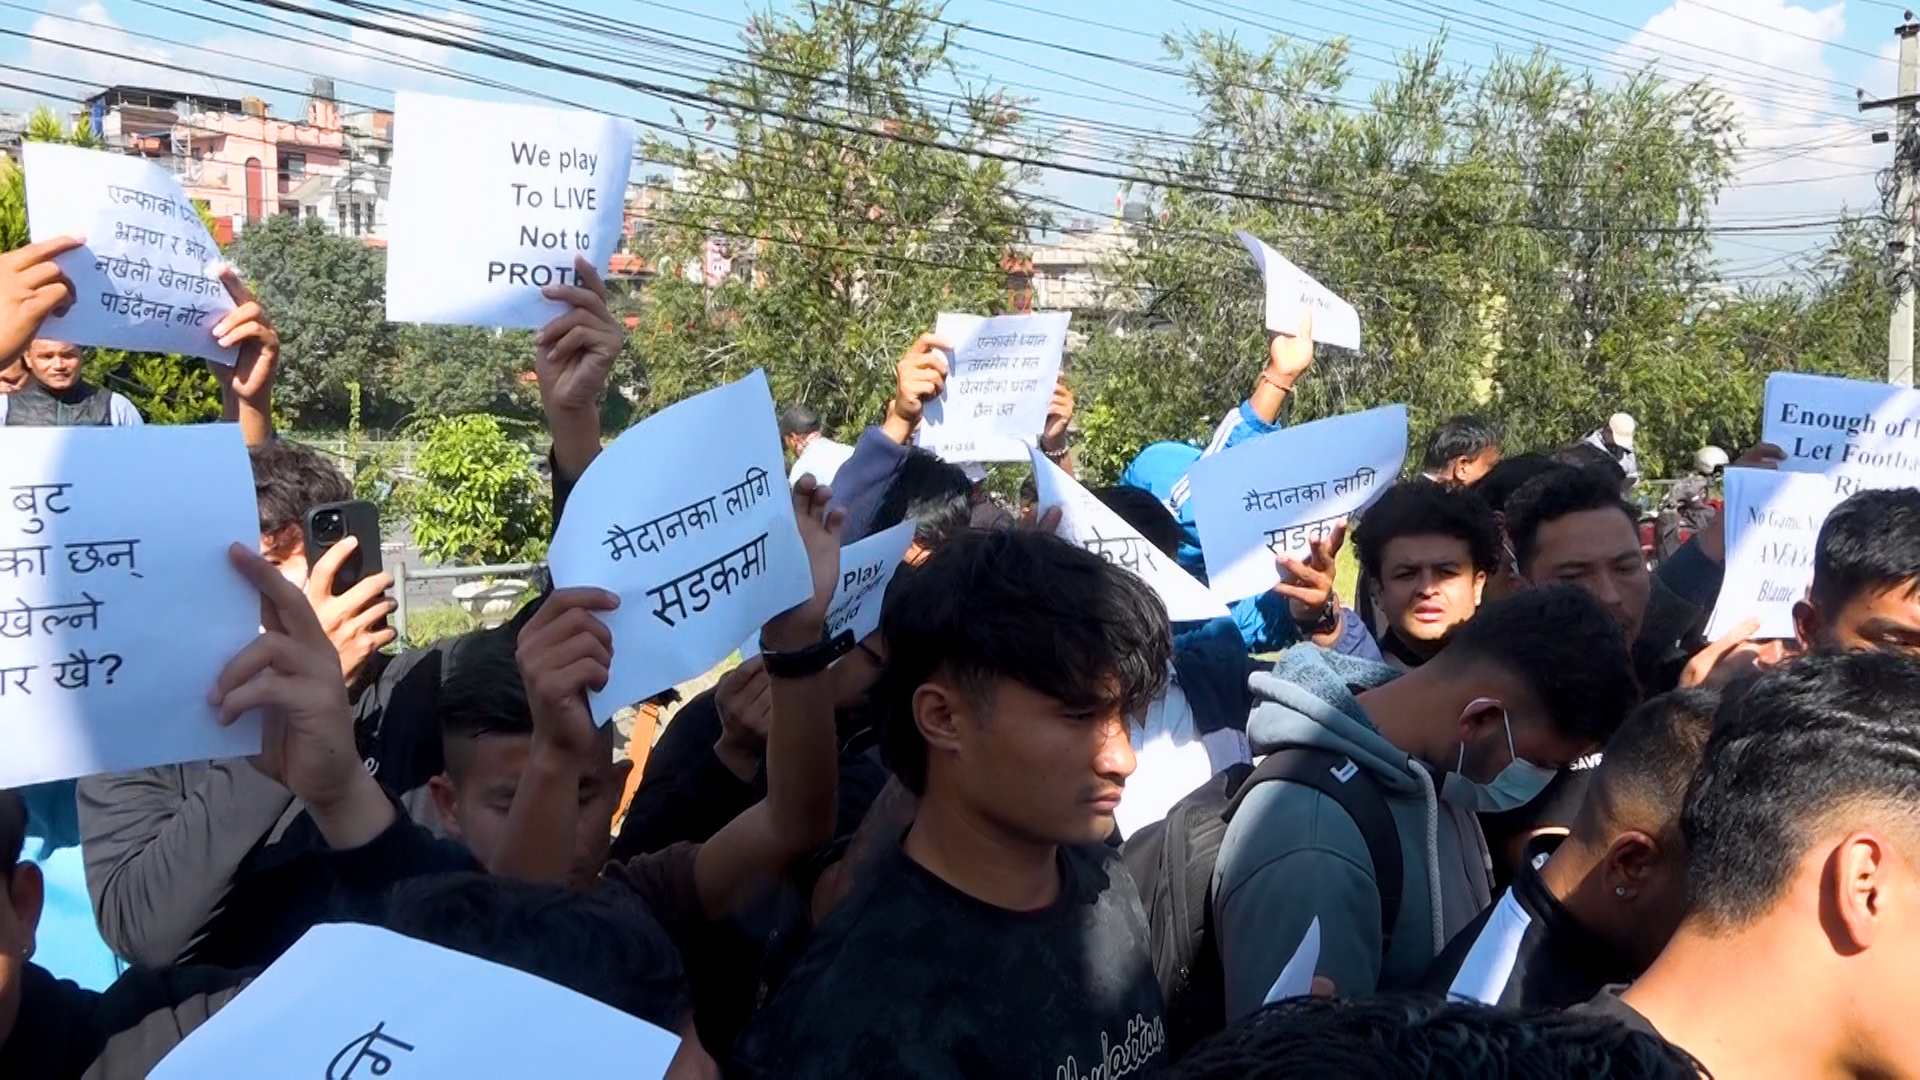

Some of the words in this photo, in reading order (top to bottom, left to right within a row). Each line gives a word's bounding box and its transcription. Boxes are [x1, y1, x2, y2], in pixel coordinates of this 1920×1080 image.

[511, 141, 550, 167] We
[559, 148, 598, 176] play
[511, 183, 543, 208] To
[554, 186, 596, 210] LIVE
[171, 235, 181, 255] र
[520, 225, 567, 249] Not
[575, 230, 590, 250] to
[176, 303, 210, 327] नोट
[1780, 401, 1876, 438] Enough
[1885, 417, 1911, 437] of
[1794, 437, 1834, 460] Let
[1242, 482, 1327, 512] मैदानका
[1333, 467, 1376, 497] लागि
[10, 483, 73, 534] बुट
[602, 496, 718, 562] मैदानका
[722, 467, 771, 516] लागि
[64, 538, 144, 578] छन्
[843, 559, 884, 592] Play
[646, 532, 769, 628] सडकमा
